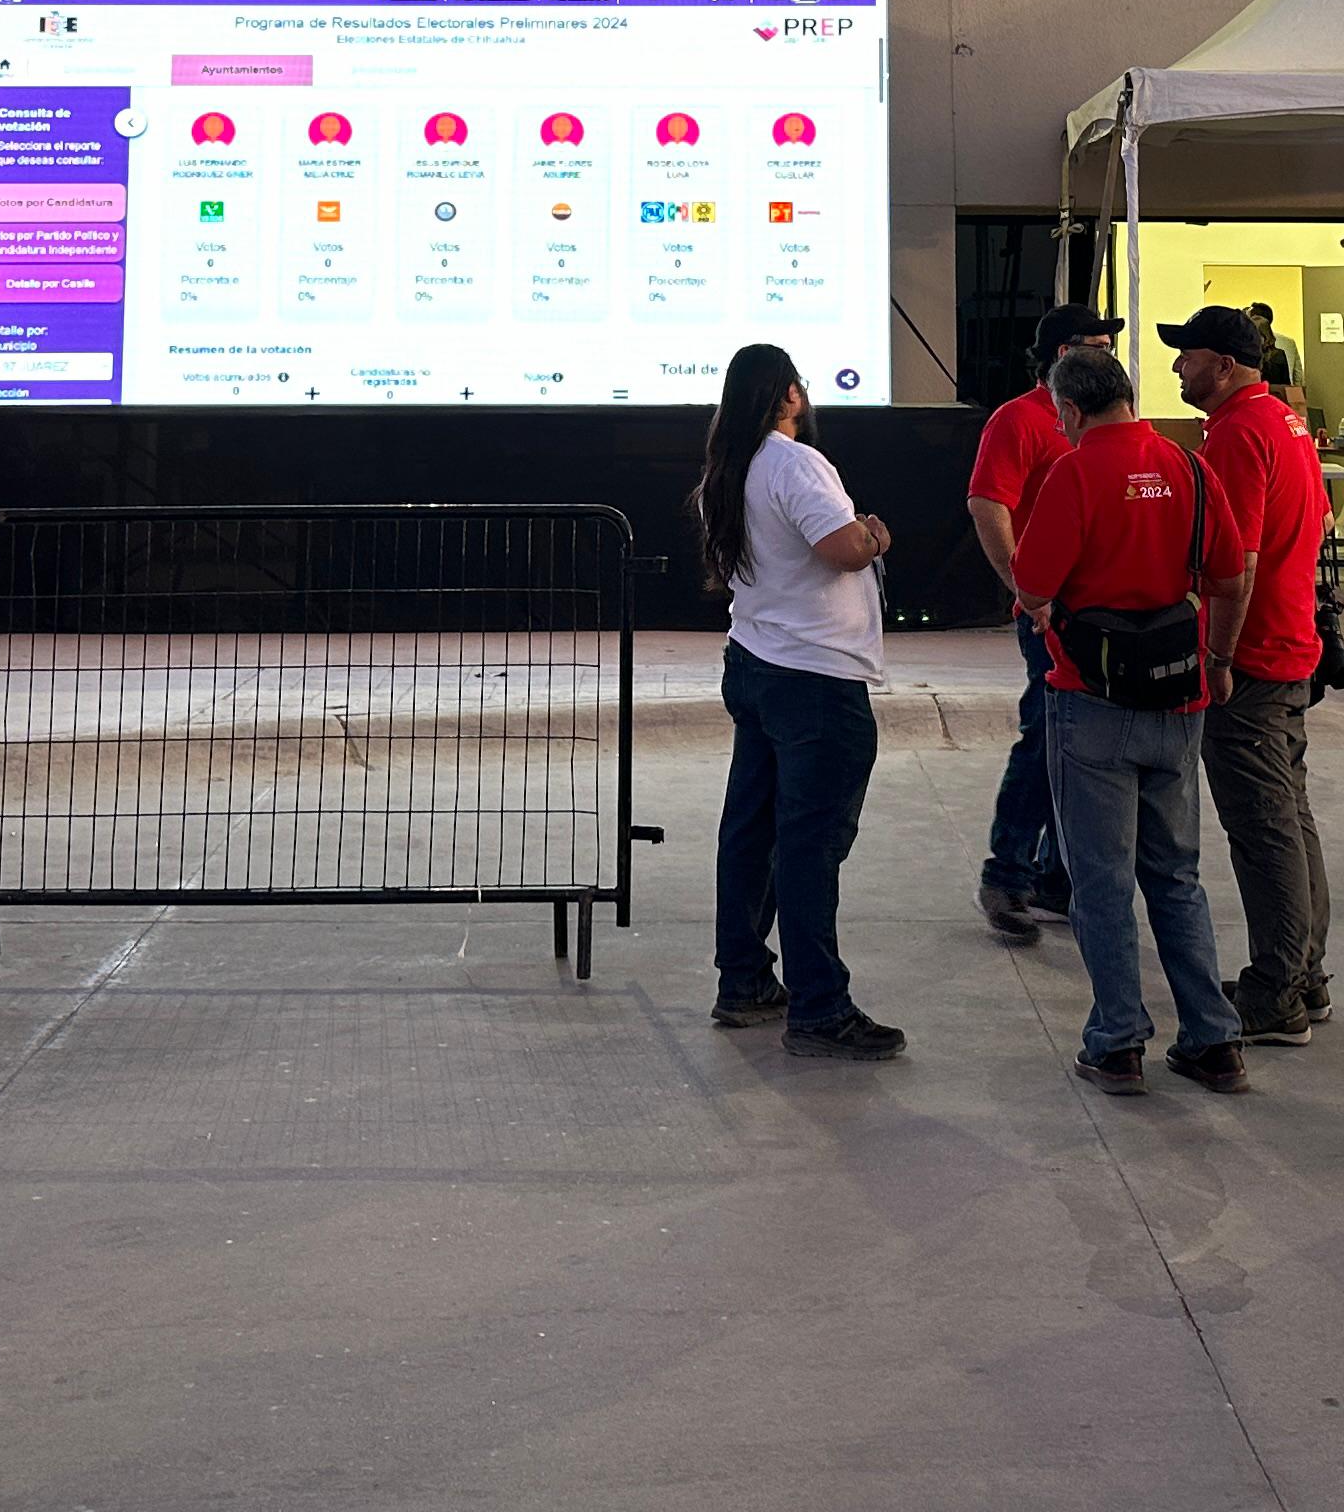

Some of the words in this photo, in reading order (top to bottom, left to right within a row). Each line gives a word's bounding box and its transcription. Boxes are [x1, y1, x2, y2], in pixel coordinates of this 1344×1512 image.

[235, 16, 304, 31] Programa
[309, 16, 327, 29] de
[332, 16, 411, 29] Resultados
[417, 16, 495, 29] Electorales
[500, 17, 588, 29] Preliminares
[592, 17, 628, 29] 2024
[784, 18, 853, 36] PREP
[398, 35, 449, 44] Estatales
[450, 35, 465, 44] de
[201, 65, 284, 76] Ayuntamientos
[55, 108, 72, 119] de
[54, 140, 63, 151] el
[64, 141, 102, 153] reporte
[17, 155, 55, 165] deseas
[26, 199, 44, 209] por
[46, 197, 113, 207] Candidatura
[16, 232, 35, 242] por
[36, 230, 72, 240] Partido
[73, 230, 110, 240] Político
[111, 232, 119, 242] y
[48, 245, 117, 256] Independiente
[196, 243, 226, 252] Votos
[314, 243, 344, 252] Votos
[430, 243, 460, 252] Votos
[547, 243, 577, 252] Votos
[663, 243, 693, 252] Votos
[780, 243, 810, 252] Votos
[207, 259, 214, 268] 0
[324, 259, 332, 268] 0
[441, 259, 448, 268] 0
[558, 259, 565, 268] 0
[675, 259, 682, 268] 0
[792, 259, 799, 268] 0
[6, 279, 41, 289] Detalle
[42, 280, 60, 290] por
[180, 275, 239, 286] Porcentaje
[298, 275, 358, 286] Porcentaje
[415, 275, 473, 286] Porcentaje
[532, 275, 590, 286] Porcentaje
[648, 275, 707, 286] Porcentaje
[766, 275, 824, 286] Porcentaje
[168, 345, 225, 355] Resumen
[228, 345, 243, 355] de
[246, 345, 257, 355] la
[260, 345, 312, 355] votación
[659, 363, 696, 375] Total
[701, 363, 719, 375] de
[183, 373, 210, 382] Votos
[362, 378, 418, 388] registradas
[232, 387, 240, 395] 0
[386, 391, 394, 400] 0
[540, 386, 547, 395] 0
[1139, 486, 1172, 499] 2024
